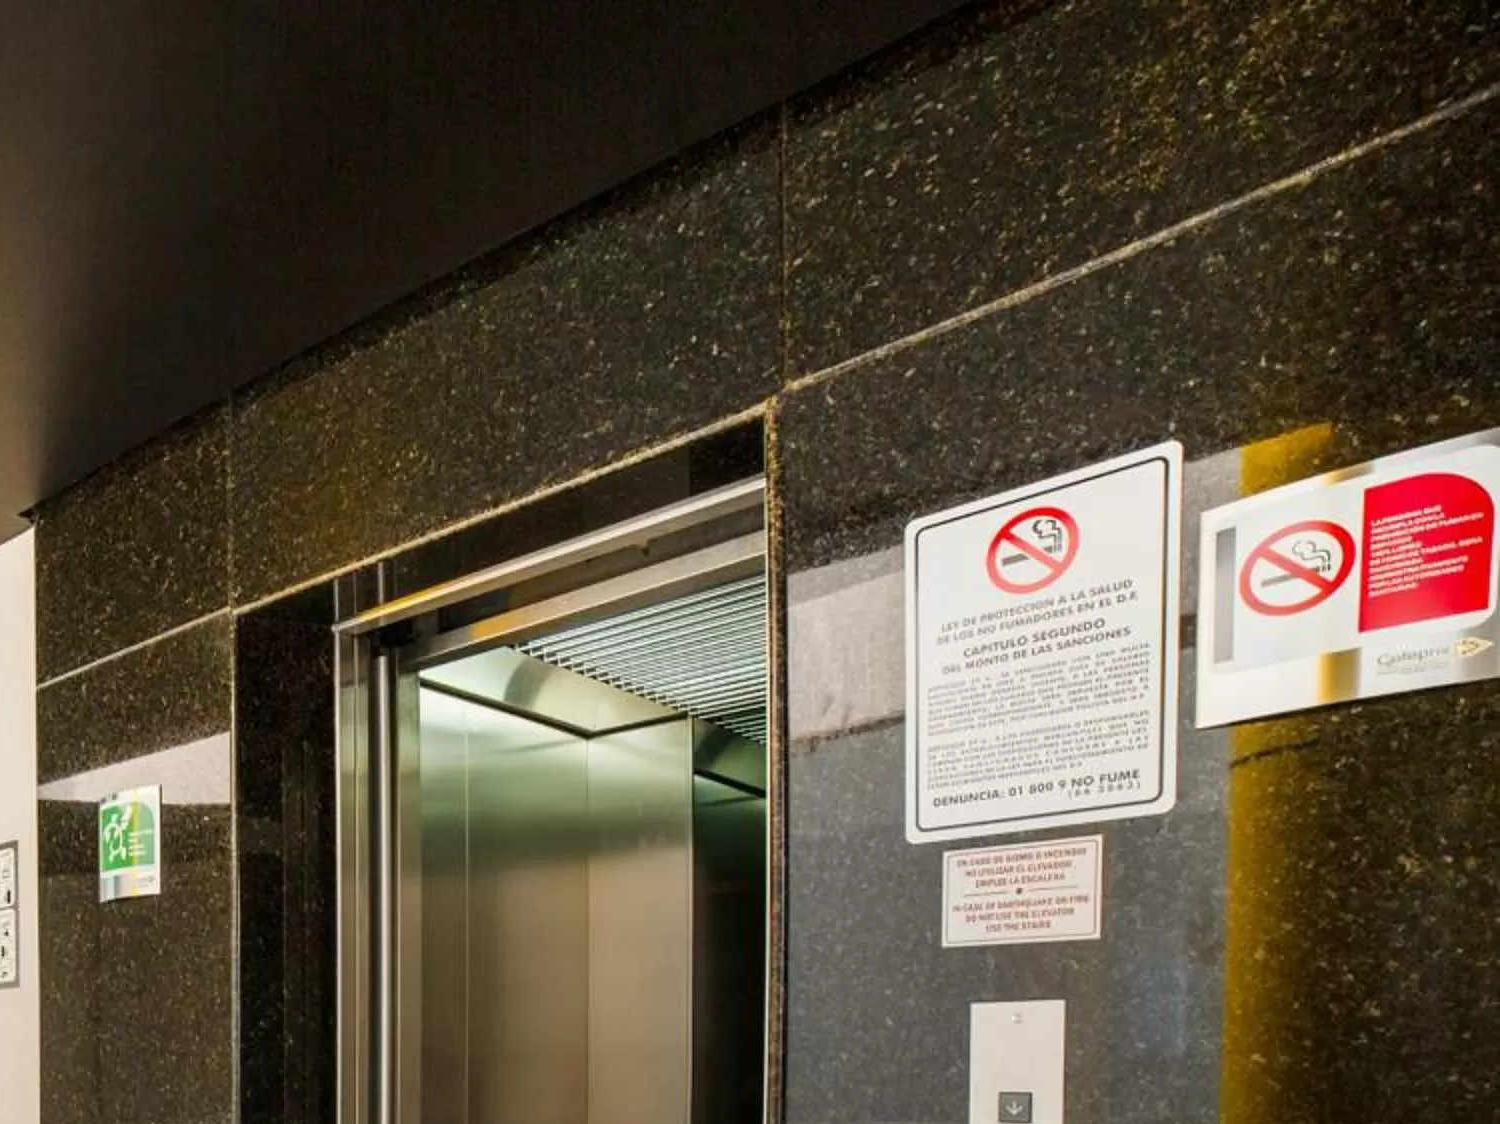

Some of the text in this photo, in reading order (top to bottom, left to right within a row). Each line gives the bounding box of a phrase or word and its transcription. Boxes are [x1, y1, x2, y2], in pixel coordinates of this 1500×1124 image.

[953, 629, 975, 641] LOS
[977, 625, 997, 635] NO
[999, 606, 1073, 630] FUMADORES
[1077, 601, 1095, 613] EN
[1099, 597, 1113, 608] EL
[963, 616, 977, 627] DE
[1058, 595, 1067, 605] A
[1070, 590, 1086, 601] LA
[1089, 579, 1133, 597] SALUD
[963, 617, 1106, 658] CAPITULO SEGUNDO
[964, 653, 1009, 669] MONTO
[1013, 649, 1027, 660] DE
[1031, 644, 1053, 657] LAS
[1056, 625, 1132, 651] SANCIONES
[1008, 785, 1023, 797] 01
[1028, 782, 1054, 795] 800
[1071, 775, 1095, 789] NO
[1099, 768, 1141, 784] FUME
